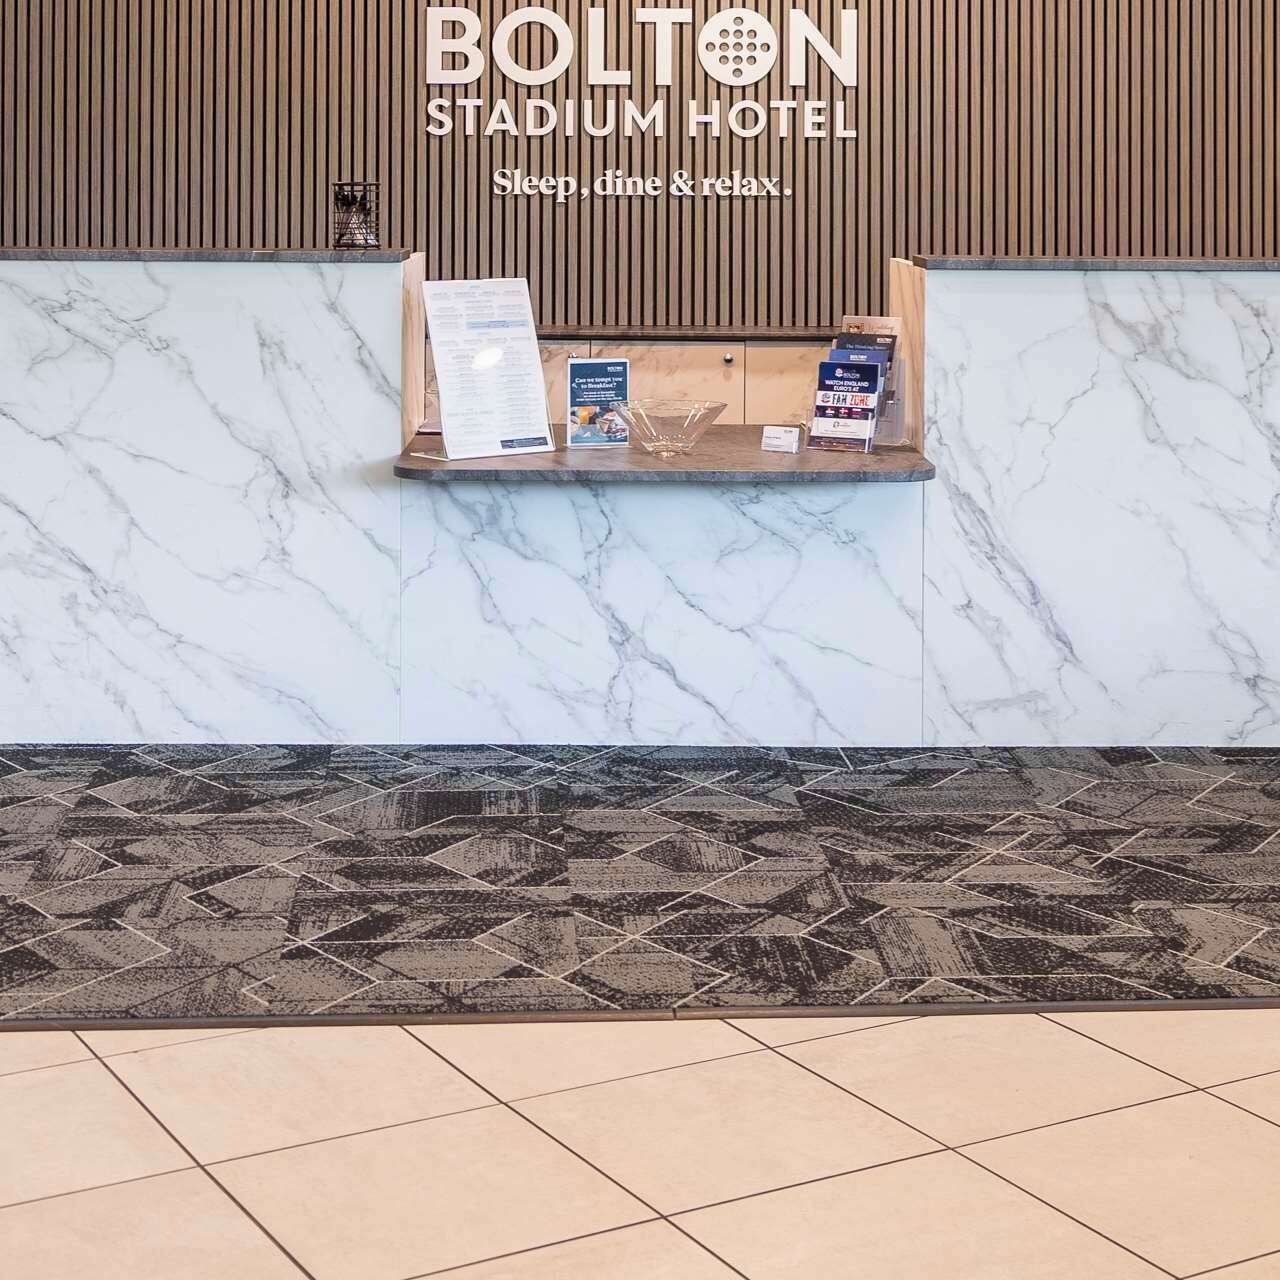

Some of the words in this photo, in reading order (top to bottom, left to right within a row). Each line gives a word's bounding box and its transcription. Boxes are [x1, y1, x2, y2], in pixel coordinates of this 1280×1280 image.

[426, 7, 858, 87] BOLTON
[426, 98, 664, 137] STADIUM
[689, 100, 857, 138] HOTEL
[493, 169, 589, 202] Sleep,
[593, 169, 663, 197] dine
[669, 170, 696, 197] &
[701, 171, 793, 197] relax.
[831, 393, 848, 405] FAN
[849, 394, 871, 407] ZONE
[844, 380, 869, 388] ENGLAND
